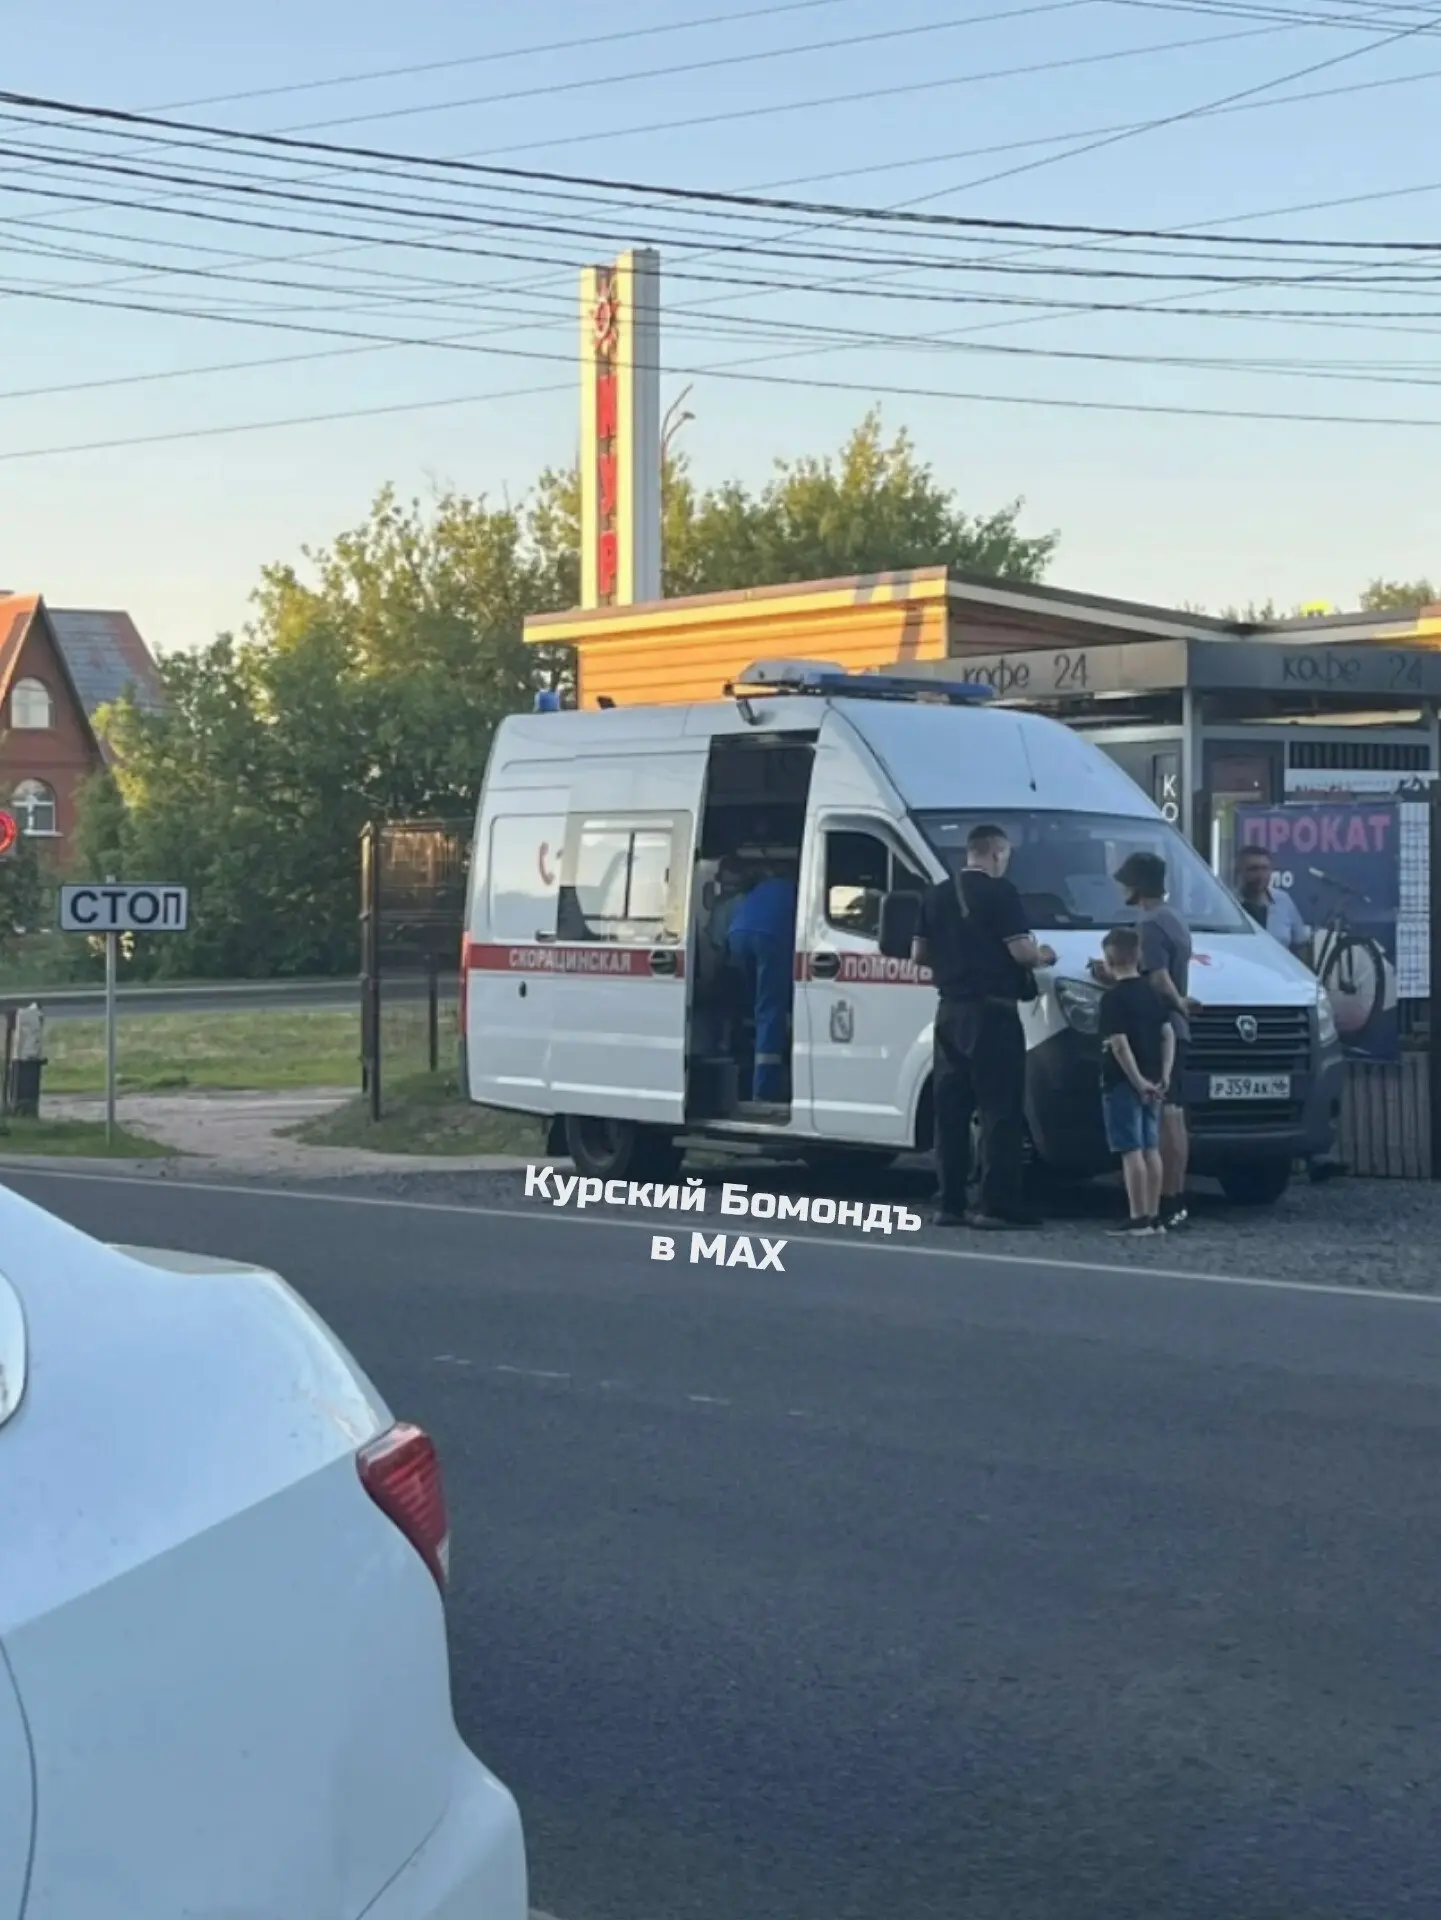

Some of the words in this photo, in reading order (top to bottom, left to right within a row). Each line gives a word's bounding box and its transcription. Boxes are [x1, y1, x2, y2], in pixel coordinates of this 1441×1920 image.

[1053, 652, 1089, 690] 24
[1387, 653, 1423, 689] 24
[1243, 814, 1391, 854] ПРОКАТ
[70, 890, 182, 925] СТОП
[843, 955, 934, 982] ПОМОЩЬ
